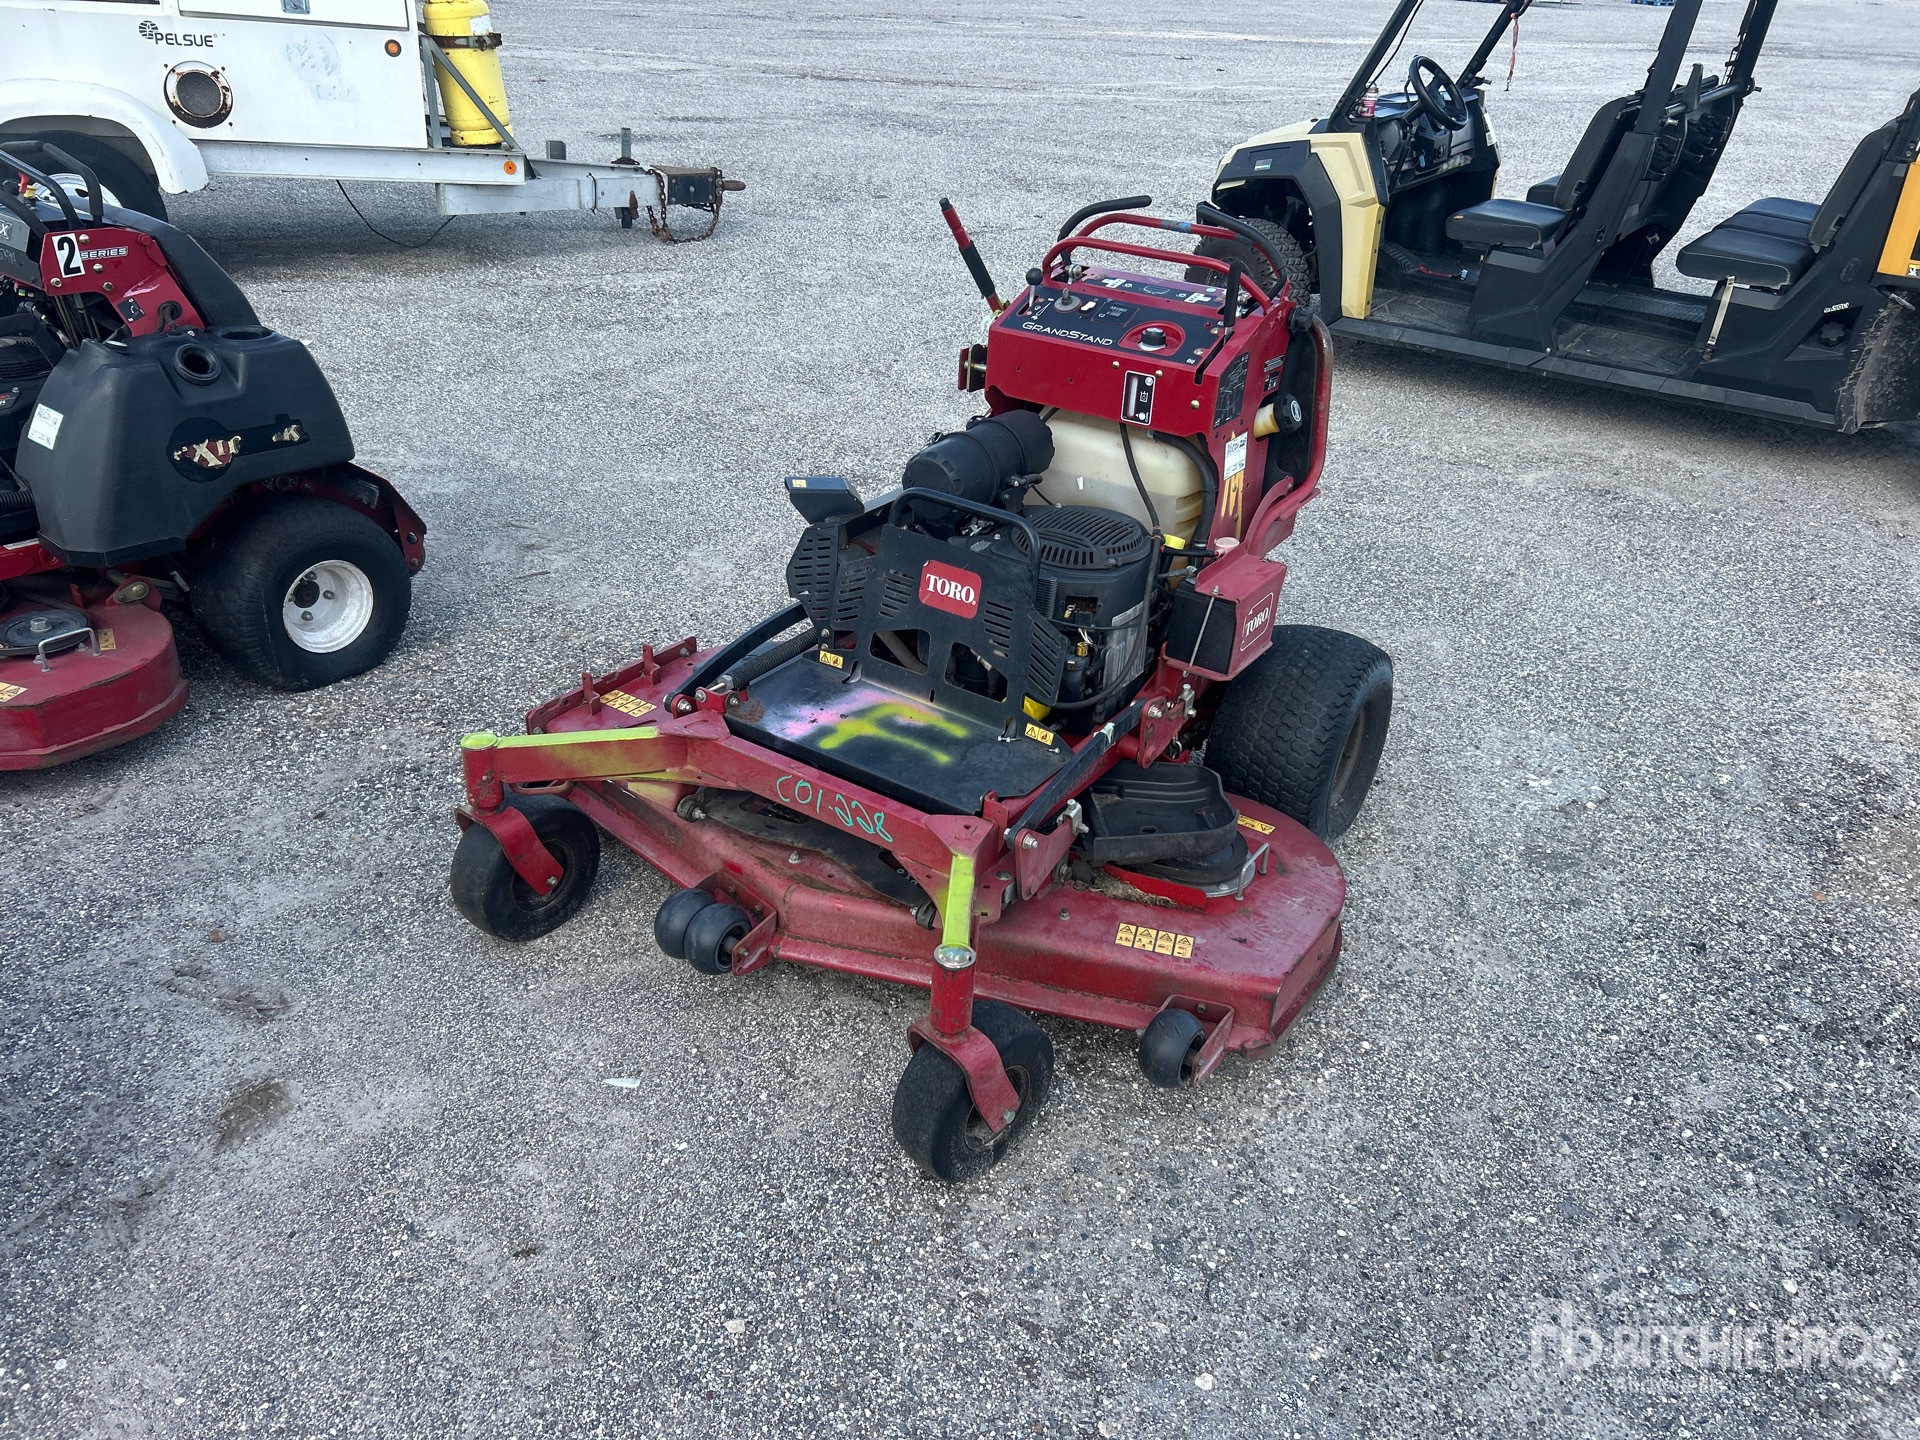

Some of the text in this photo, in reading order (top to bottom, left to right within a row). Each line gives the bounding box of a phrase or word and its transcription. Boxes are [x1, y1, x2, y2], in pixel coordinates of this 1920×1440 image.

[154, 32, 214, 48] PELSUE
[80, 247, 128, 260] SERIES
[926, 573, 975, 604] TORO
[1245, 607, 1269, 638] TORO
